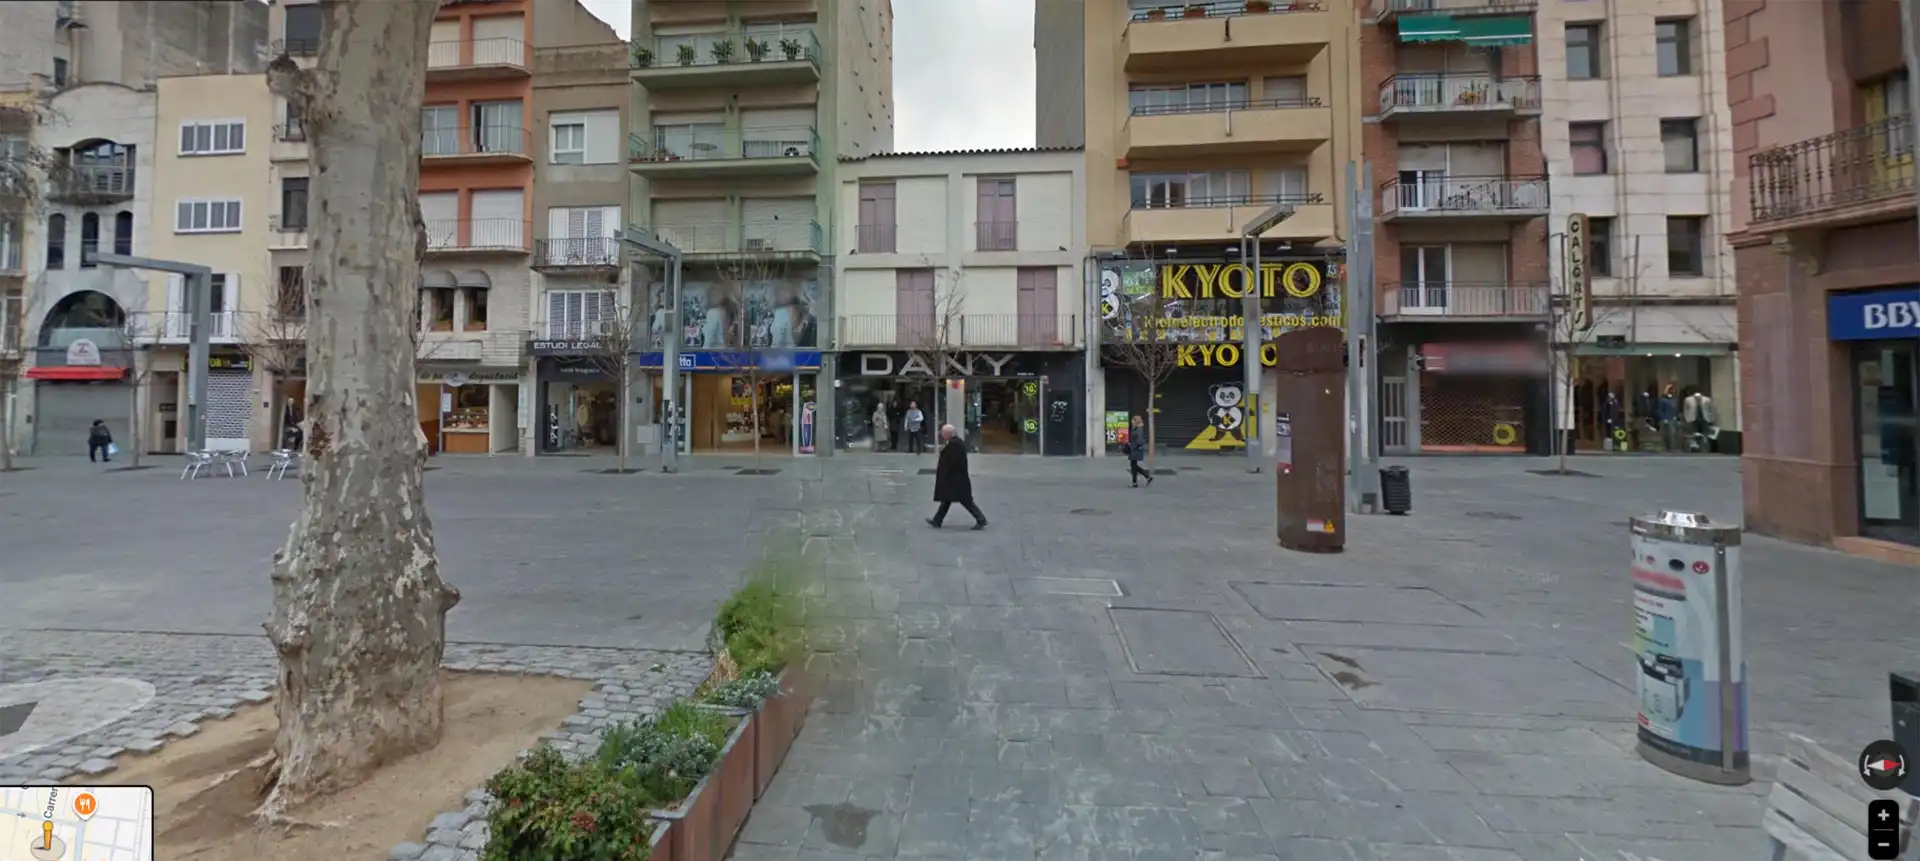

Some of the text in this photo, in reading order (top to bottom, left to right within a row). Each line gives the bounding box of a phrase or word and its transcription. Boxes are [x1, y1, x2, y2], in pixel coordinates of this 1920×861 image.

[1161, 262, 1321, 299] KYOTO
[861, 353, 1015, 376] DANY
[1176, 343, 1277, 367] KYOO
